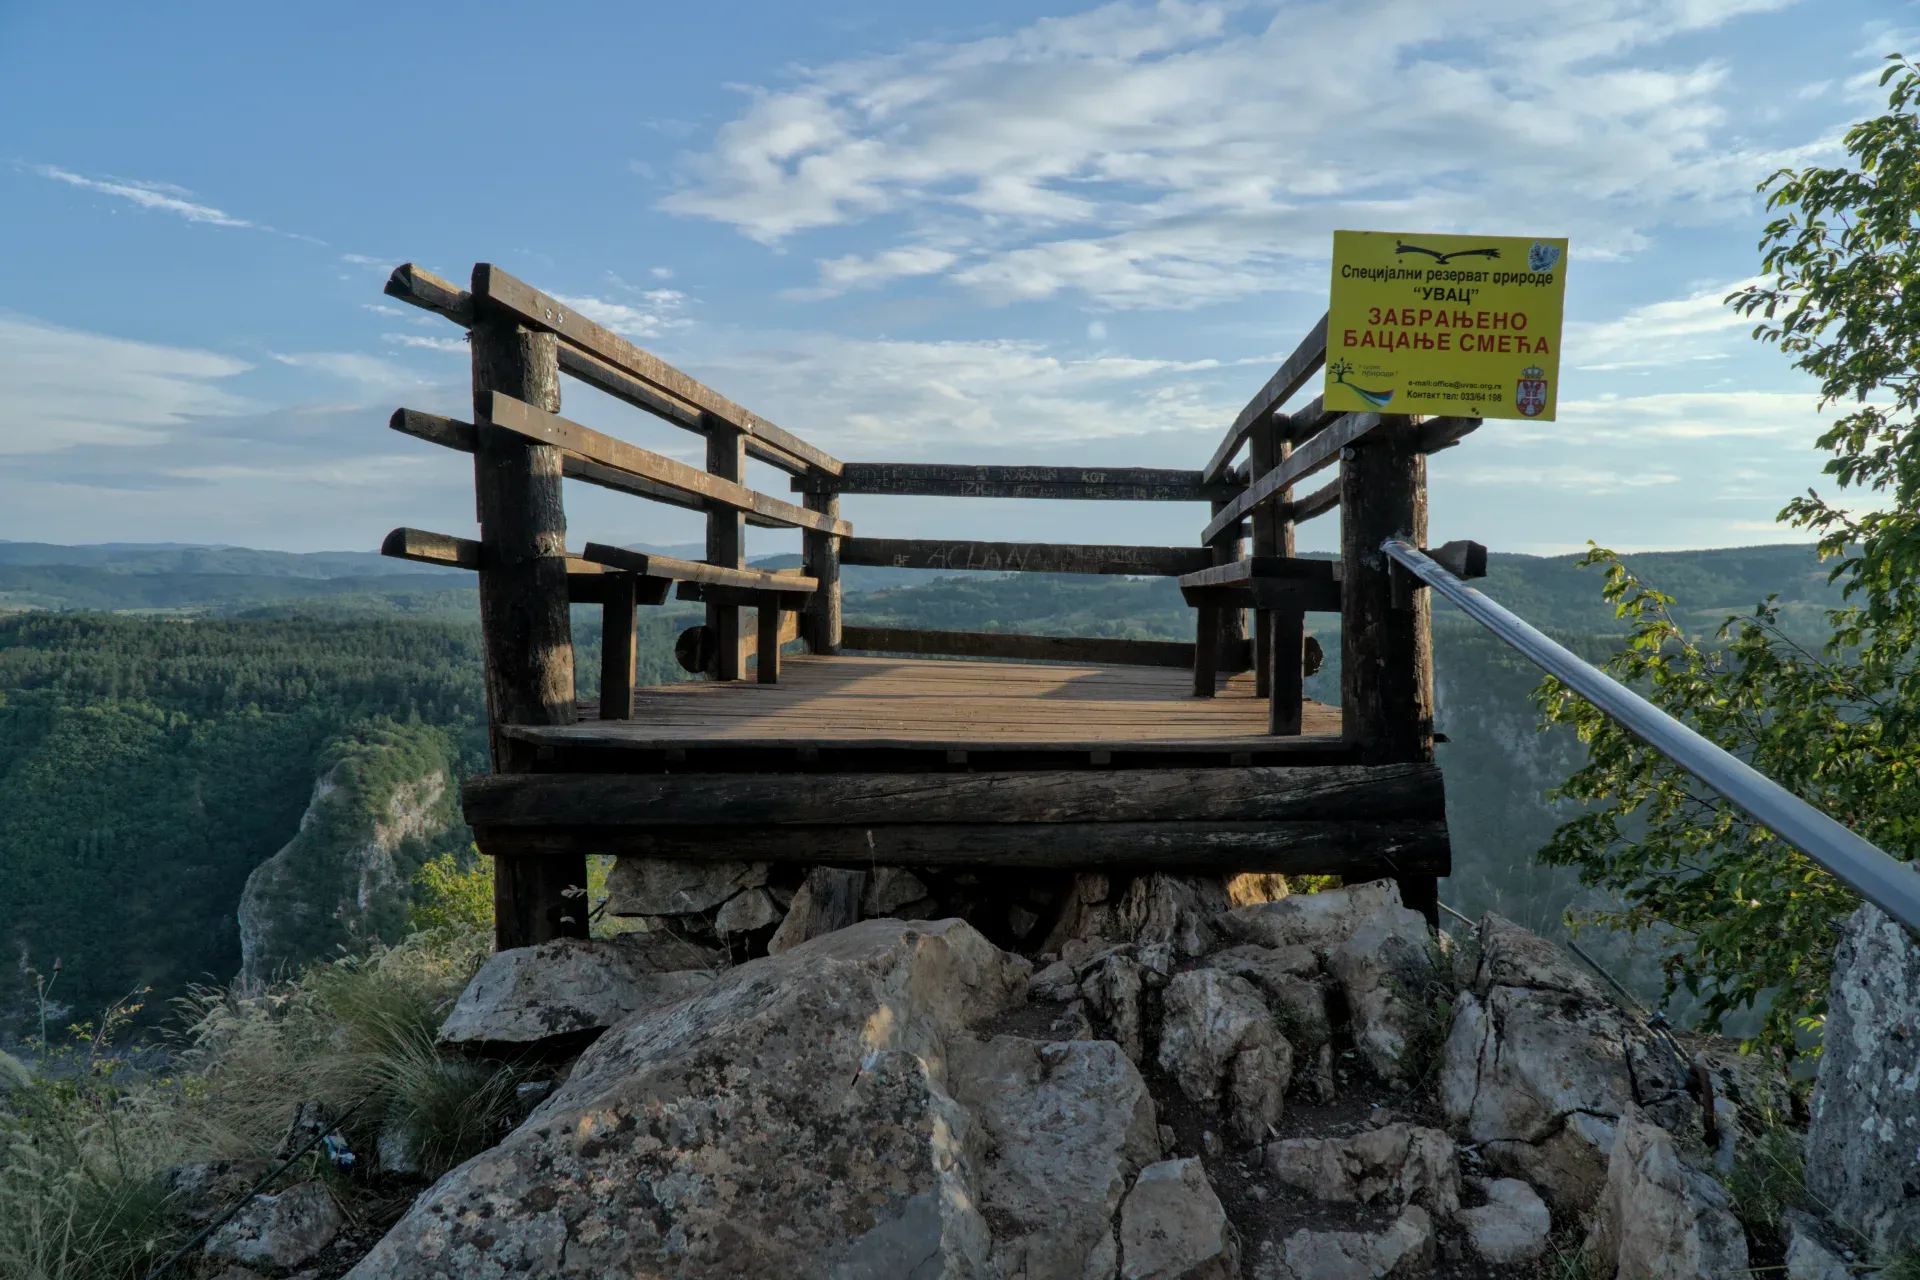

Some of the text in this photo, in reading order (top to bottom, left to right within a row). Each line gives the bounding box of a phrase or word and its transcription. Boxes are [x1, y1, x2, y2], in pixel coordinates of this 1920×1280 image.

[1342, 264, 1553, 286] Специјални резерват природе
[1368, 307, 1527, 331] ЗАБРАЊЕНО
[1344, 329, 1550, 354] БАЦАЊЕ СМЕЋА
[1407, 390, 1440, 399] Контакт
[1443, 392, 1458, 400] тел:
[1461, 392, 1485, 401] 033/64
